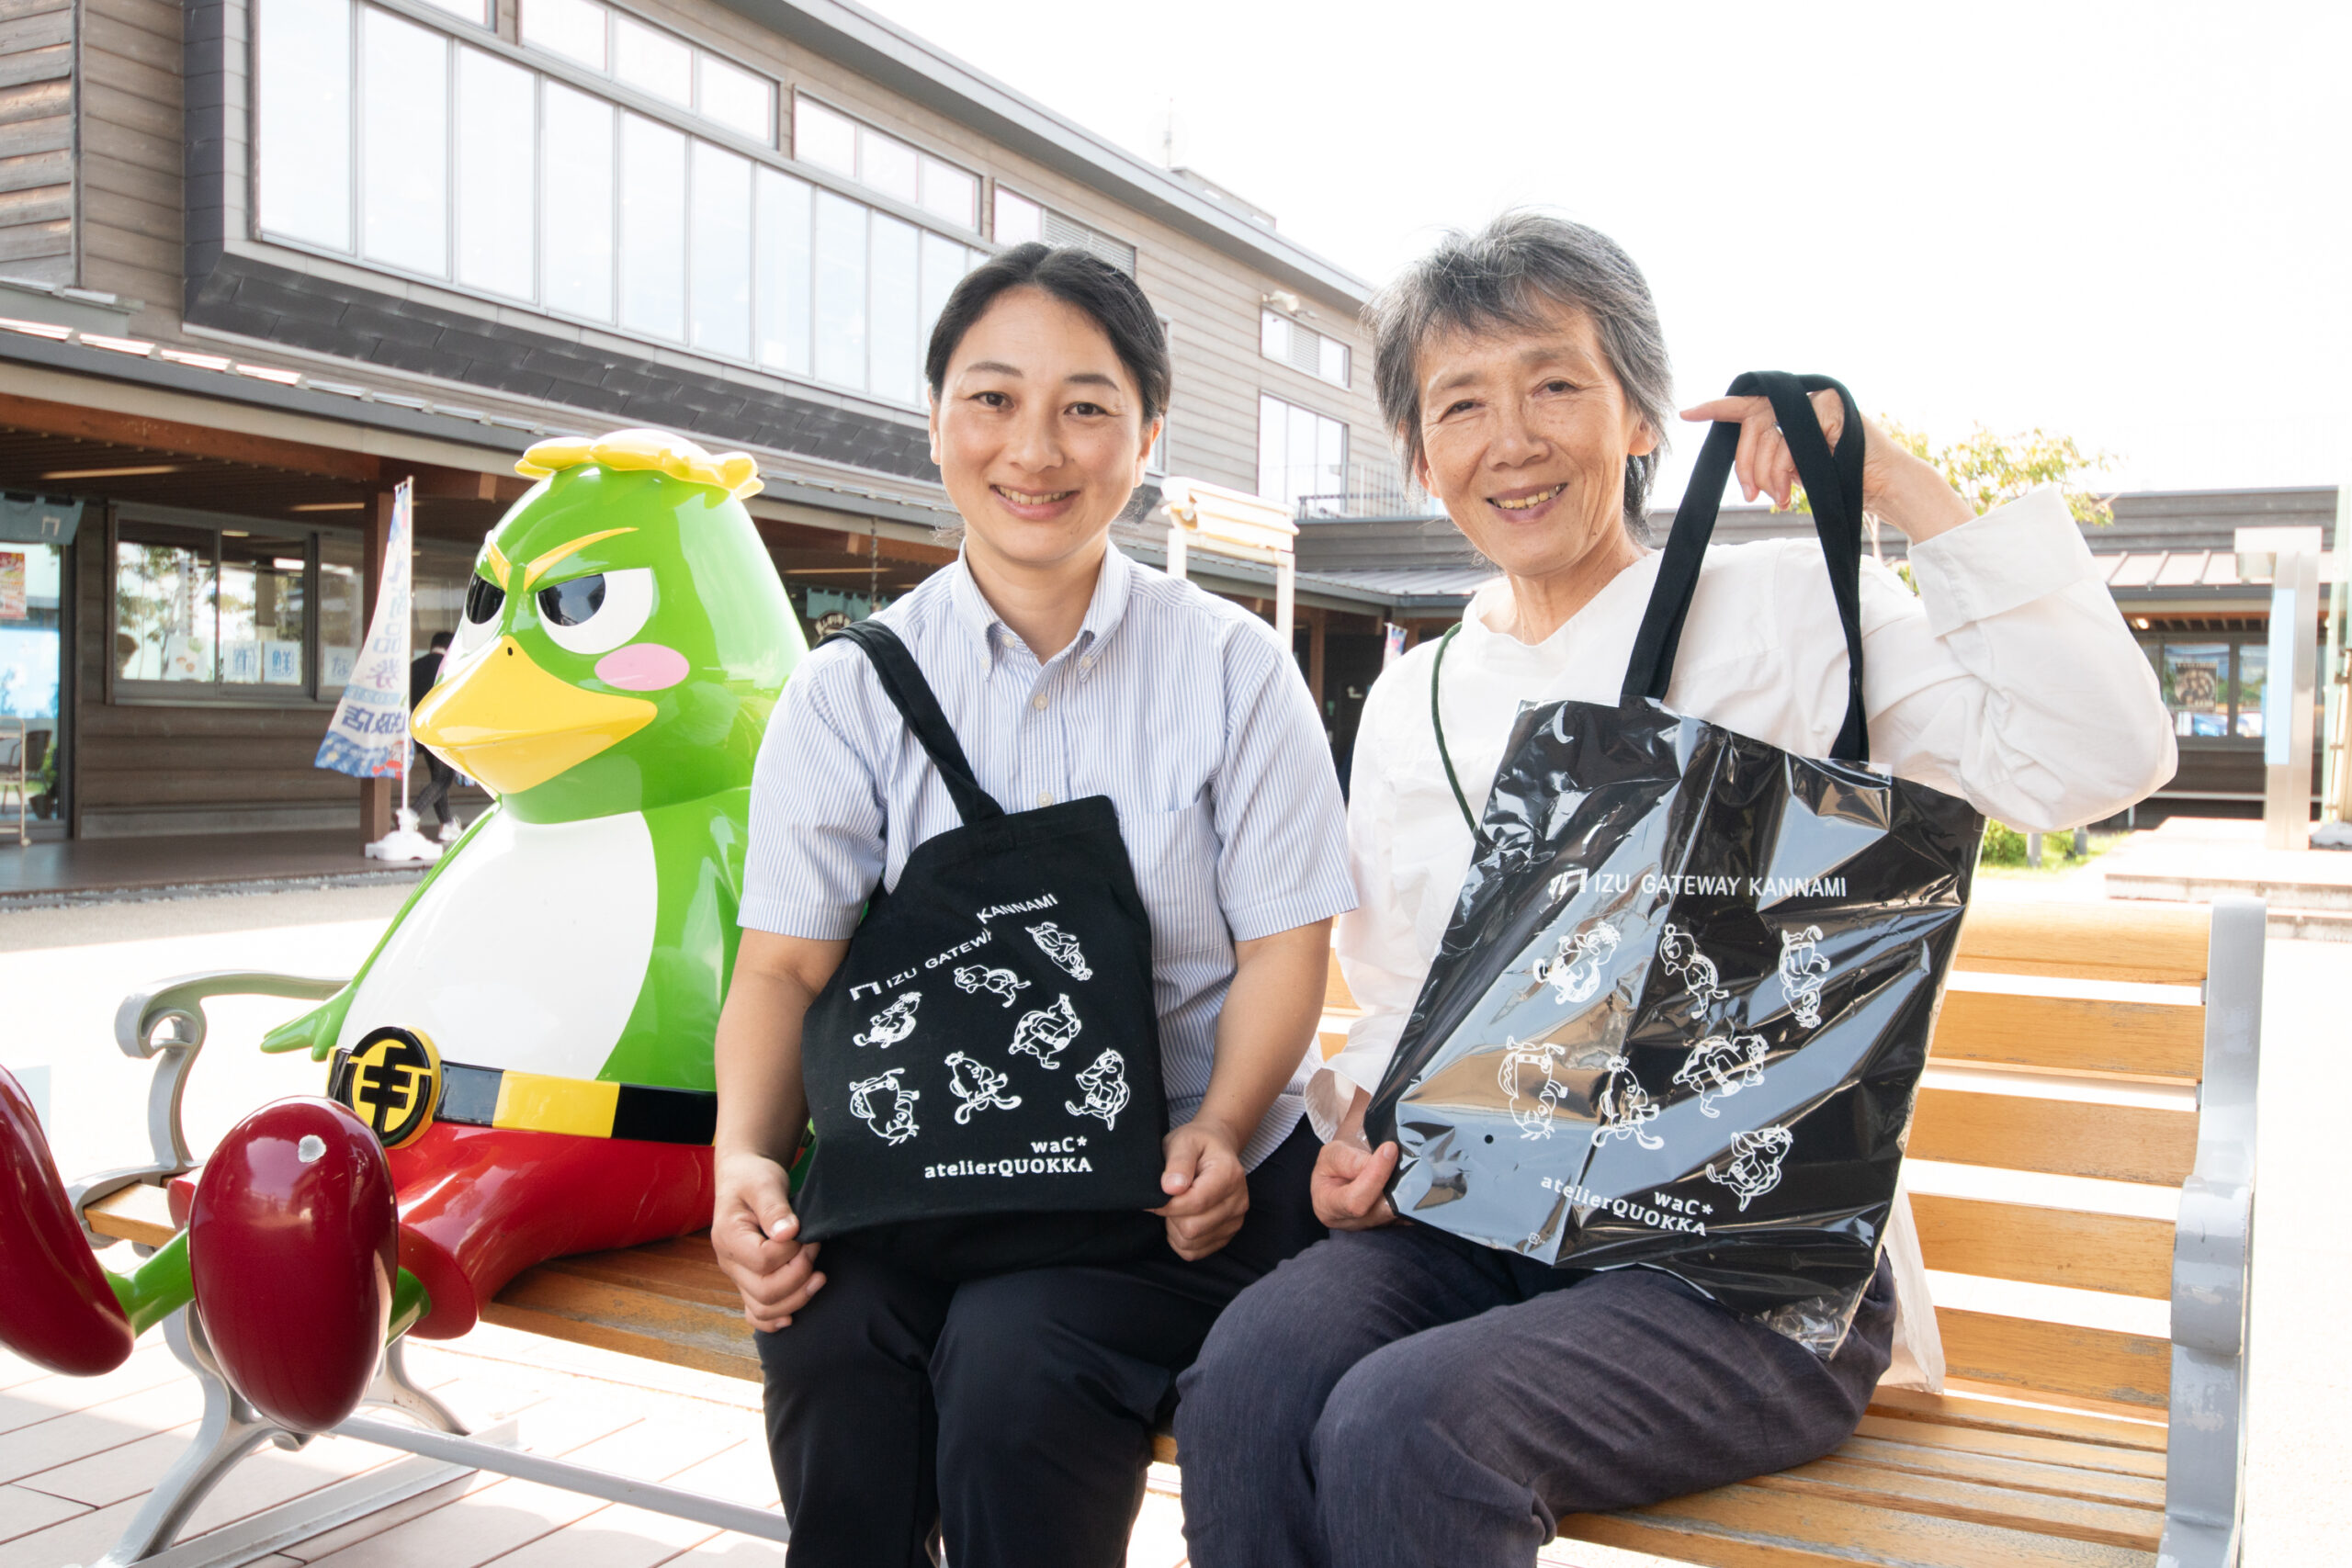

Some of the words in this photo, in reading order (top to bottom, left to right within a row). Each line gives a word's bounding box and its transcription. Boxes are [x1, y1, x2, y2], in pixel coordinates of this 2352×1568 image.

[1594, 874, 1630, 894] IZU
[1641, 874, 1741, 897] GATEWAY
[1748, 876, 1847, 897] KANNAMI
[887, 967, 917, 988] IZU
[977, 893, 1058, 924] KANNAMI
[924, 1156, 1093, 1179] atelierQUOKKA
[1540, 1176, 1707, 1237] atelierQUOKKA
